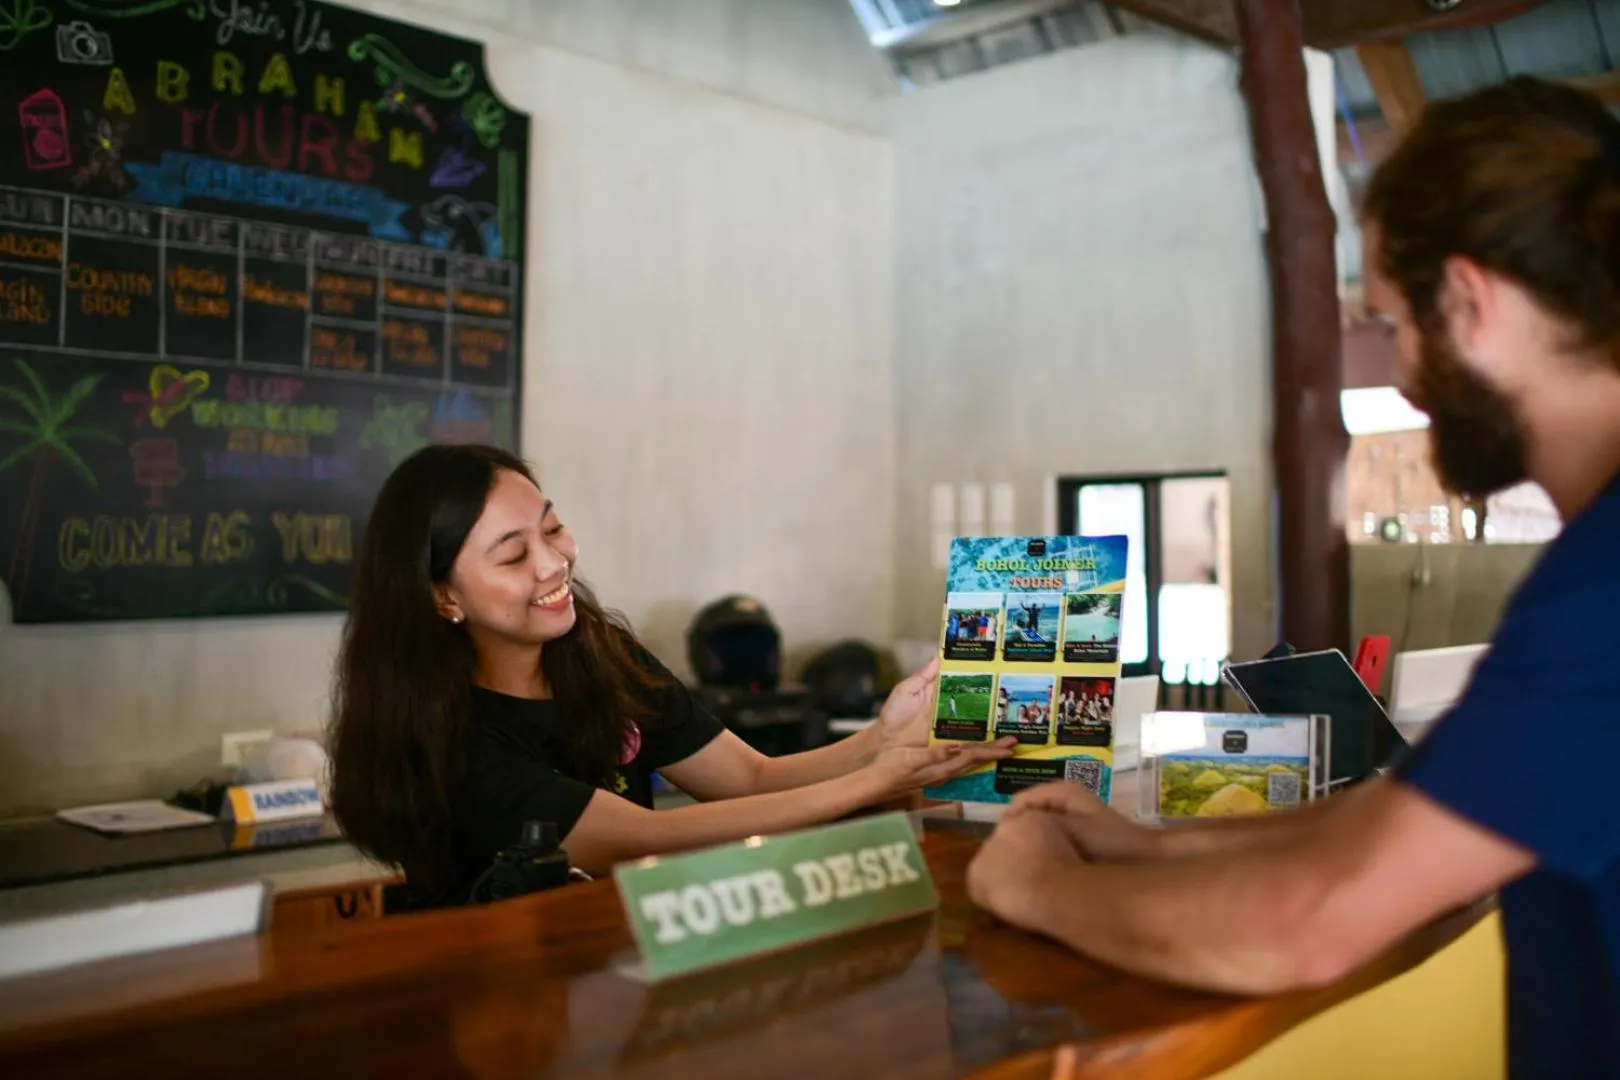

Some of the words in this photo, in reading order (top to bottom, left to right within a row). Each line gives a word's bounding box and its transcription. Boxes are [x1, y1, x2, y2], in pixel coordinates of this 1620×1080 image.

[103, 51, 423, 170] ABRAHAM
[180, 98, 375, 181] TOURS
[71, 201, 152, 237] MON
[58, 516, 194, 572] COME
[202, 510, 255, 563] AS
[270, 510, 354, 565] YOU
[976, 559, 1028, 571] BOHOL
[1033, 558, 1096, 571] JOINER
[1010, 576, 1063, 588] TOURS
[640, 869, 796, 943] TOUR
[793, 841, 919, 907] DESK
